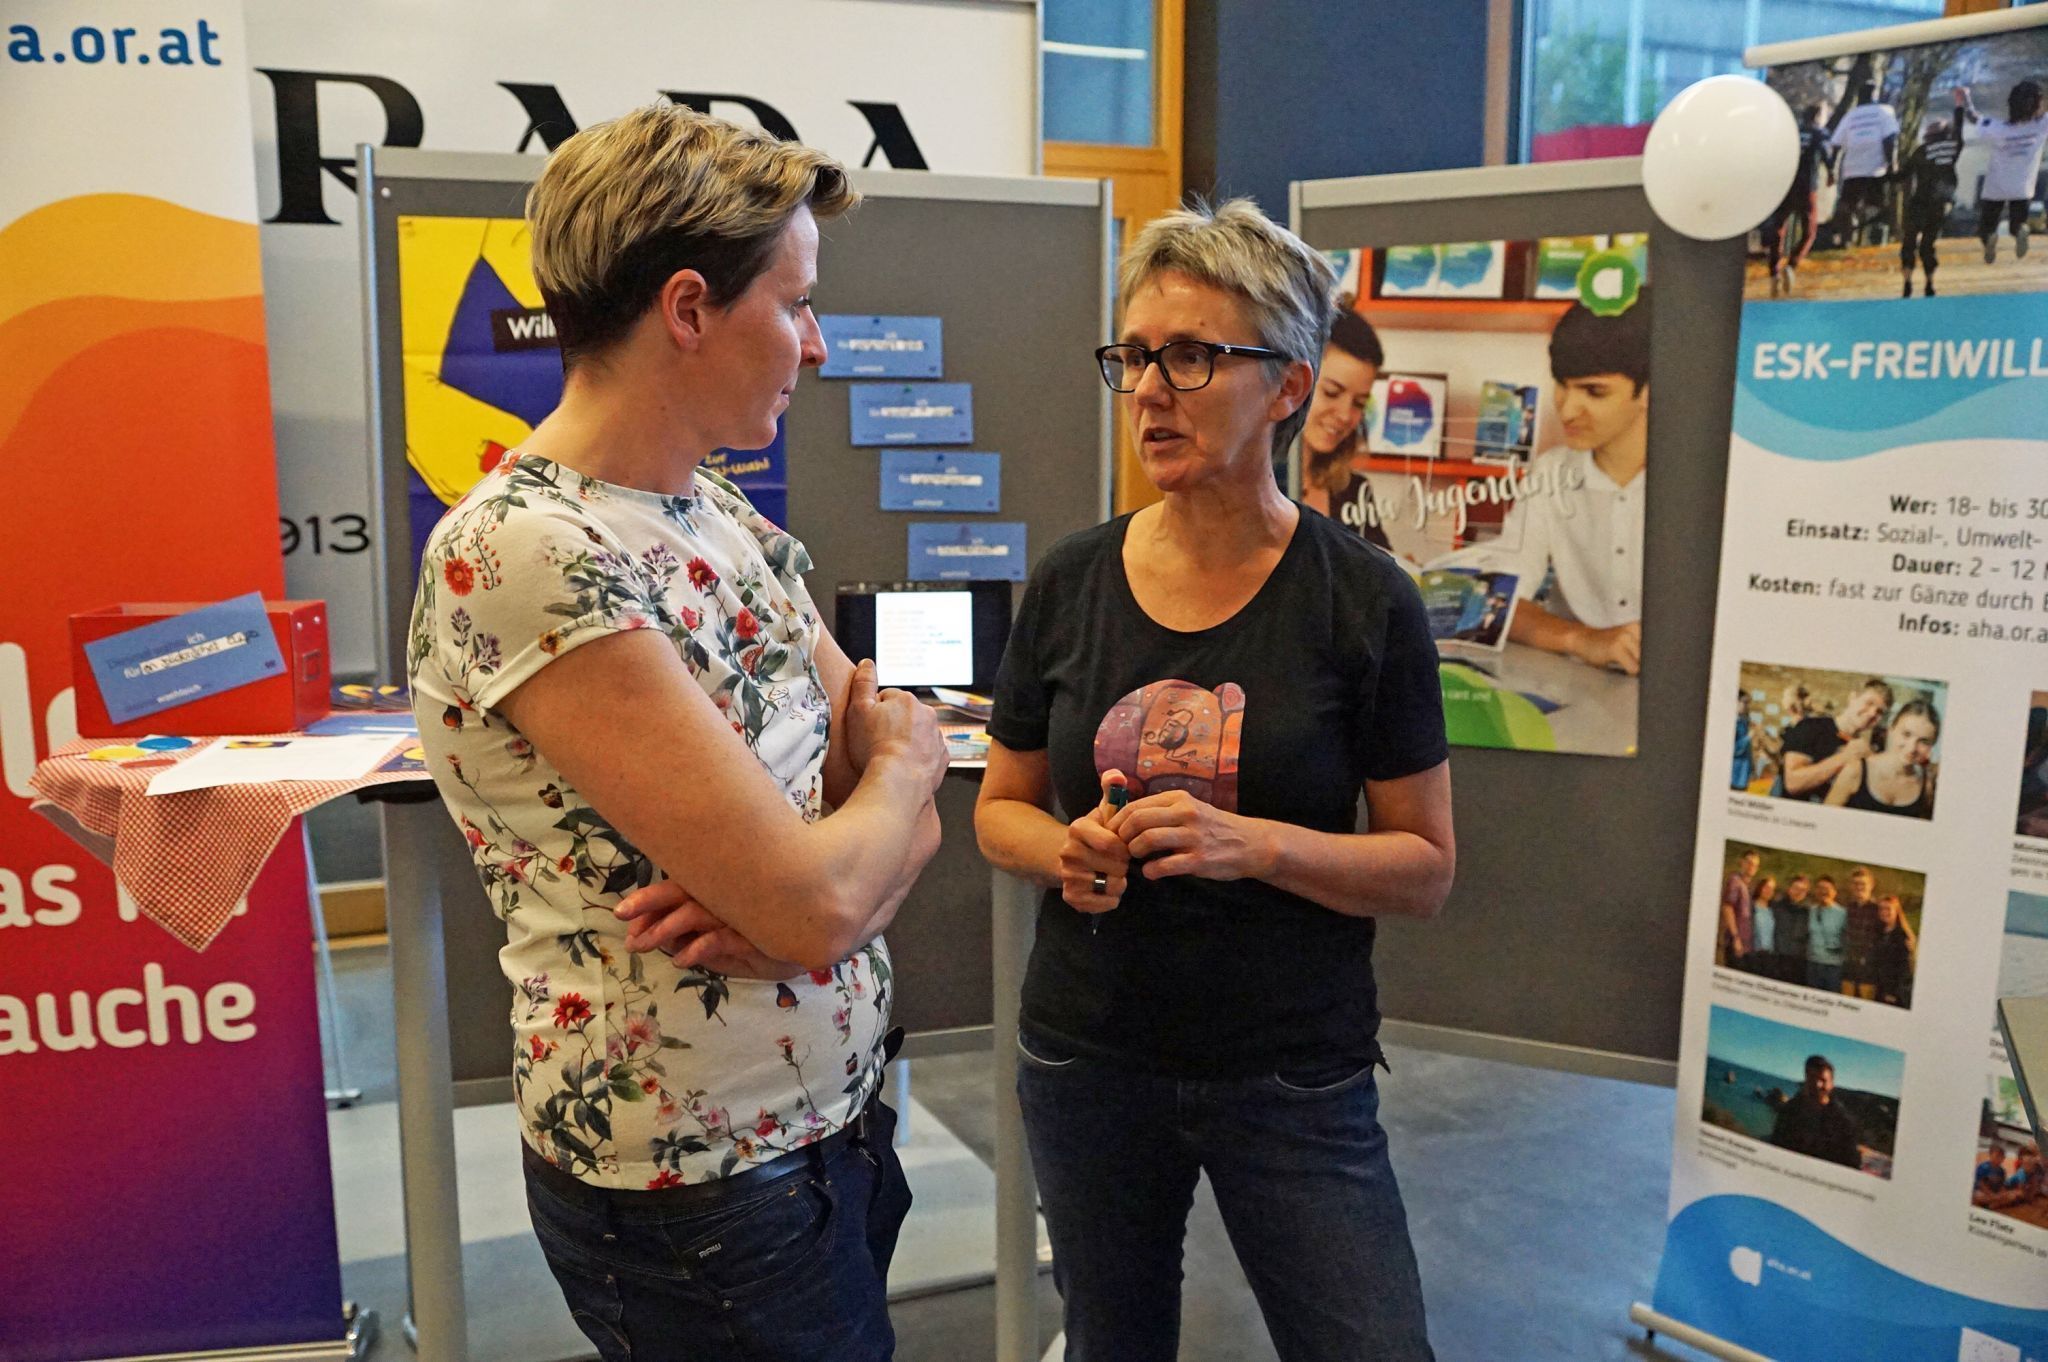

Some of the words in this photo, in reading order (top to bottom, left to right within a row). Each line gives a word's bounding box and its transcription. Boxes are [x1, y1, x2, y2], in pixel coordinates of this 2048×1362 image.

[8, 19, 222, 66] a.or.at
[1753, 337, 2048, 380] ESK-FREIWILL
[1890, 494, 1937, 516] Wer:
[1948, 496, 1981, 517] 18-
[1988, 498, 2018, 519] bis
[1786, 519, 1869, 542] Einsatz:
[1877, 522, 1948, 547] Sozial-,
[1957, 526, 2043, 550] Umwelt-
[1892, 553, 1961, 577] Dauer:
[1969, 556, 1983, 578] 2
[2011, 558, 2036, 582] 12
[1748, 573, 1822, 597] Kosten:
[1828, 576, 1865, 600] fast
[1872, 584, 1903, 602] zur
[1910, 582, 1969, 608] Gänze
[1976, 588, 2034, 612] durch
[1899, 612, 1961, 636] Infos:
[0, 962, 257, 1056] auche
